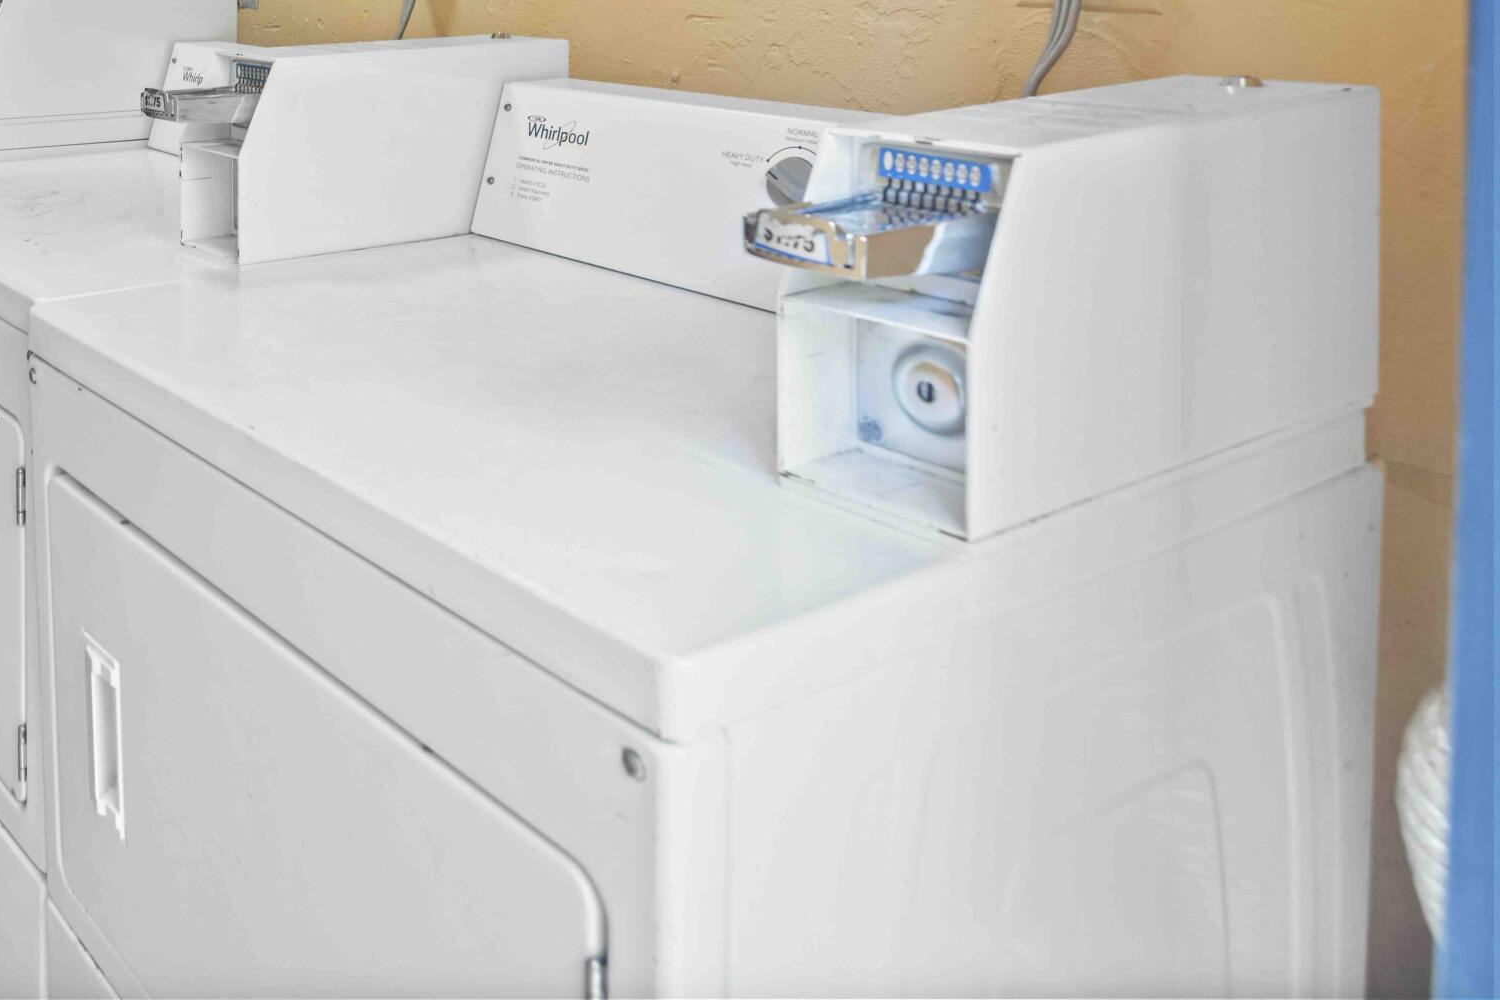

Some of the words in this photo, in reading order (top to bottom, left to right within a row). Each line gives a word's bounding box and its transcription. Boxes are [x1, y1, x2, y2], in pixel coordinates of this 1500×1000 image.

[183, 70, 204, 86] Whirlp
[528, 121, 590, 147] Whirlpool
[787, 127, 819, 138] NORMAL
[722, 150, 744, 160] HEAVY
[744, 153, 764, 163] DUTY
[516, 162, 547, 175] OPERATING
[547, 167, 590, 183] INSTRUCTIONS
